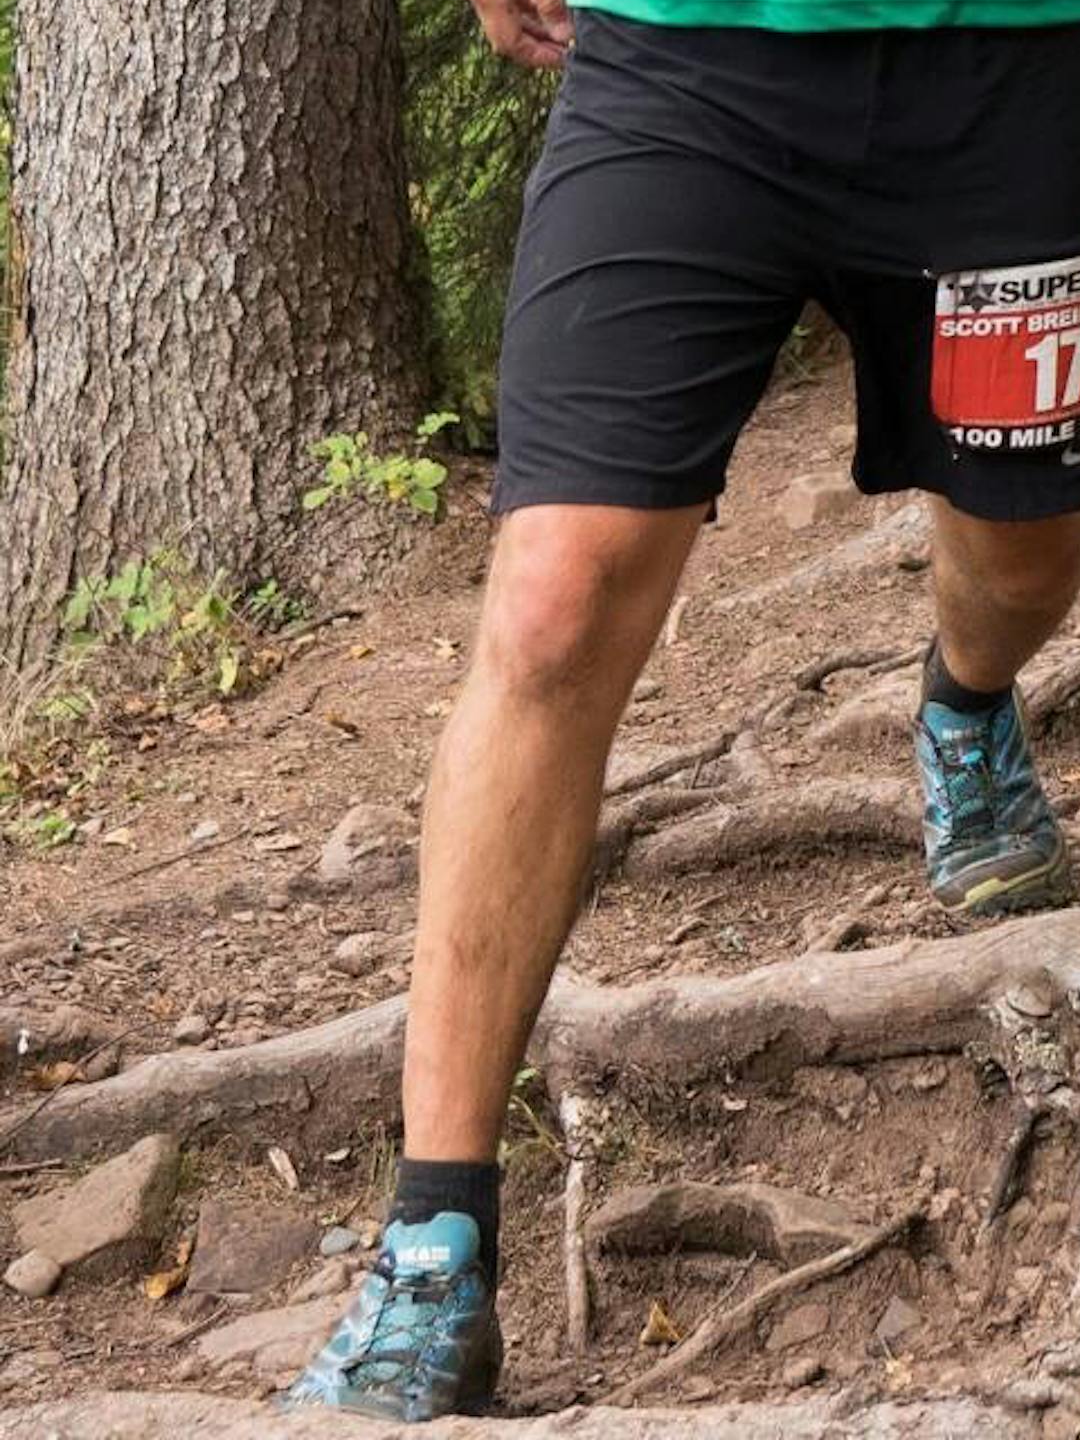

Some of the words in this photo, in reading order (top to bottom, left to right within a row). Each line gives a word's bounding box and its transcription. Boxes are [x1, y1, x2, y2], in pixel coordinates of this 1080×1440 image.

[940, 317, 1023, 337] SCOTT
[950, 427, 1003, 447] 100
[1009, 419, 1076, 448] MILE
